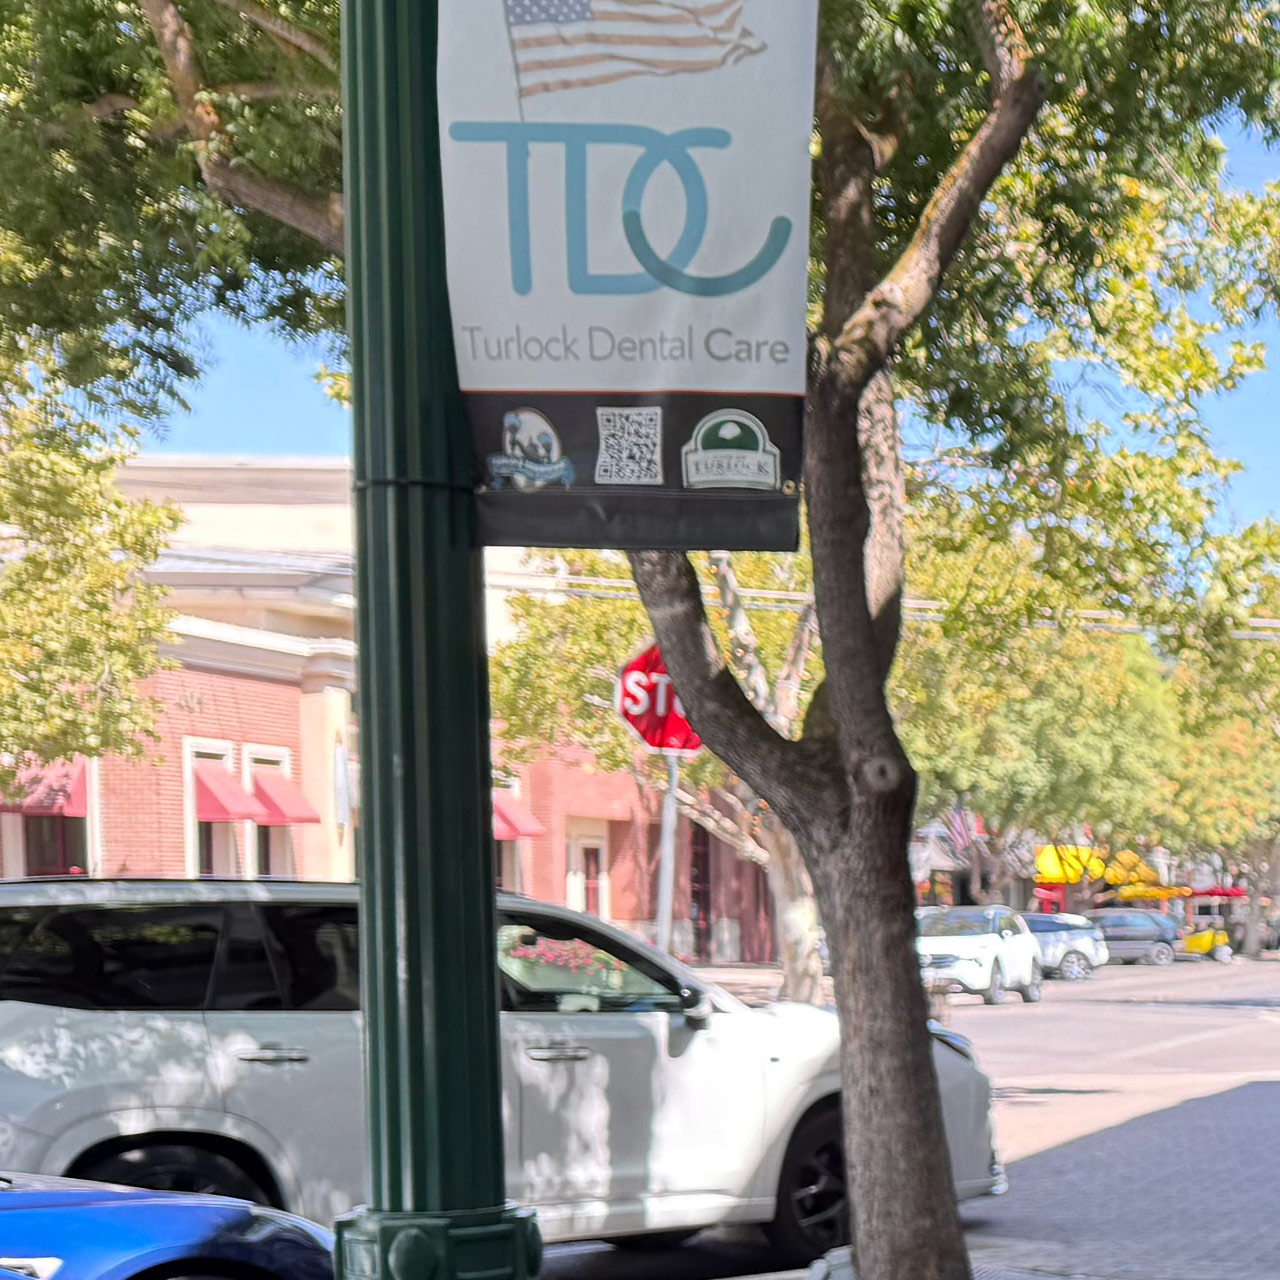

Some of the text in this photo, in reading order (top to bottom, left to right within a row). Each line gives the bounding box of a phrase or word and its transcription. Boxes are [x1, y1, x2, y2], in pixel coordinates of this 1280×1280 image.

[461, 324, 789, 364] Turlock Dental Care
[693, 459, 770, 476] TURLOCK
[623, 670, 686, 718] ST
